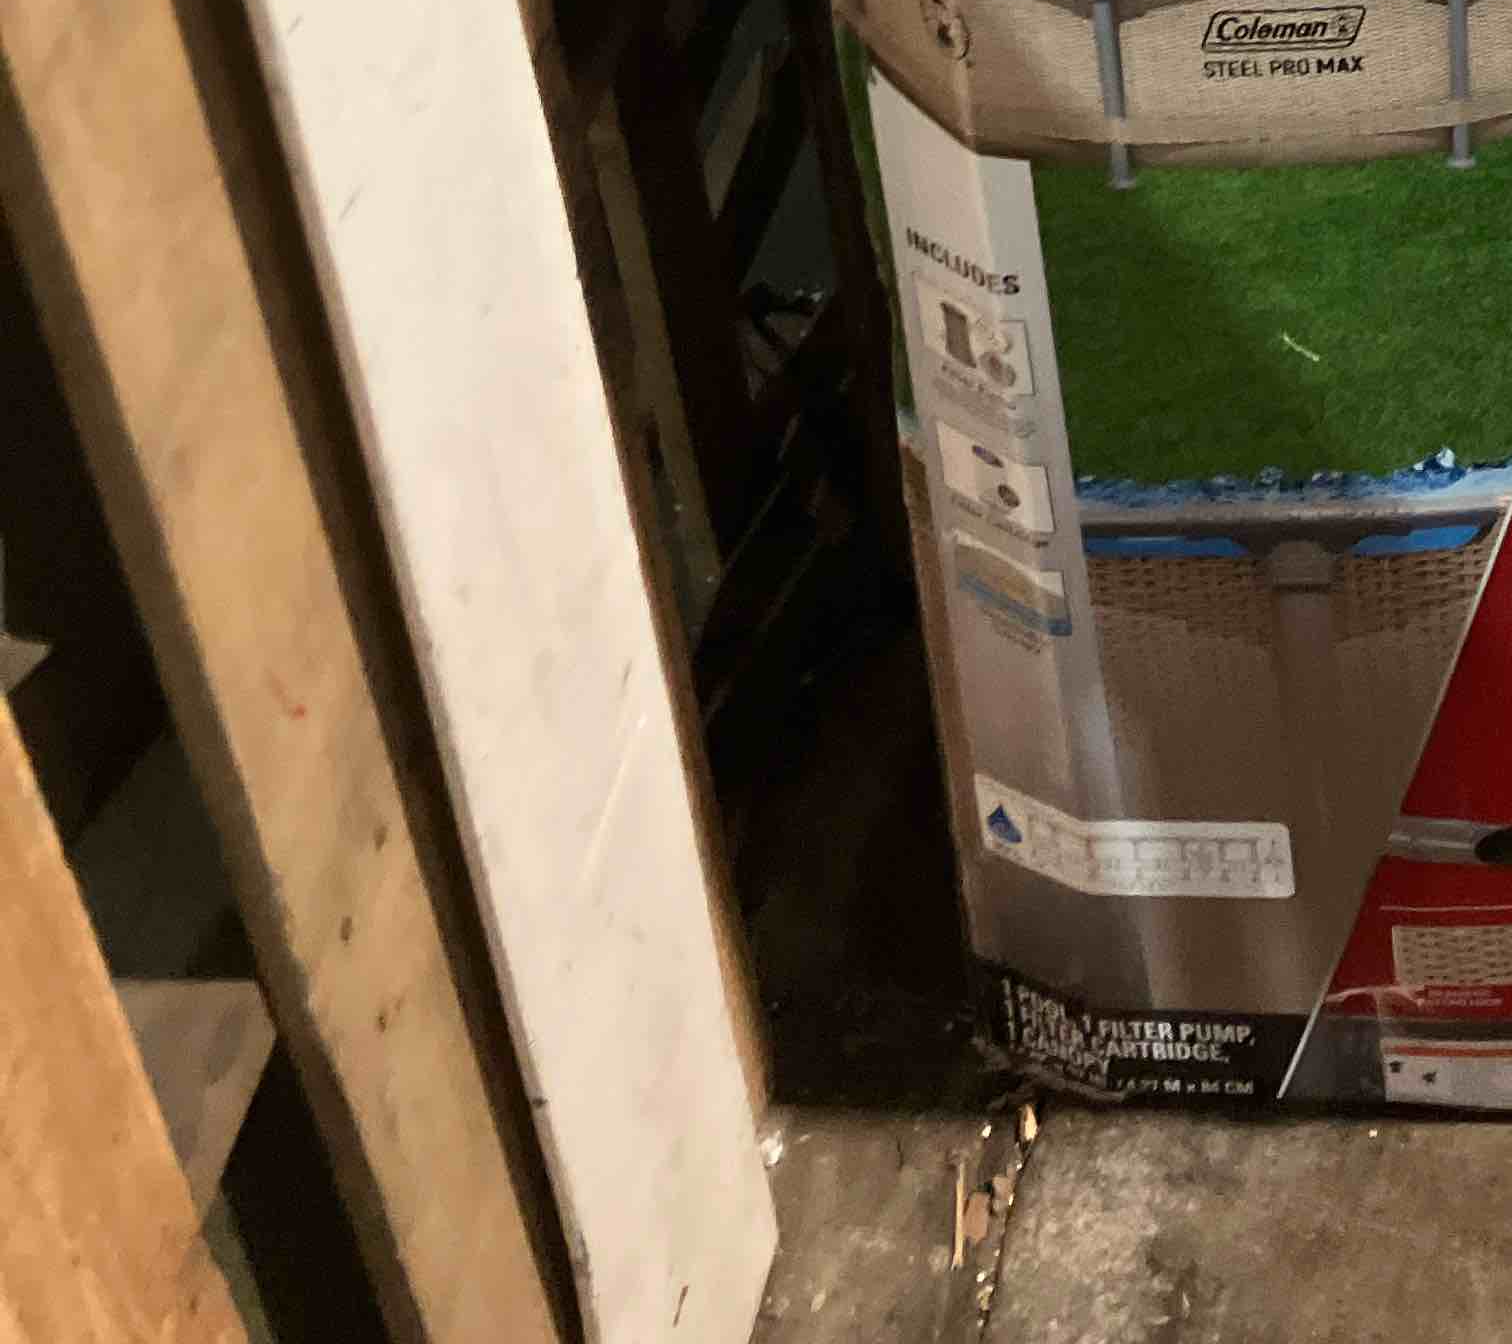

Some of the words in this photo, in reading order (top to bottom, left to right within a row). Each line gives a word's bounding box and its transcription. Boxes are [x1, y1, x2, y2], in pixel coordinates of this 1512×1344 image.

[1215, 15, 1328, 42] Coleman
[1202, 59, 1263, 80] STEEL
[1269, 58, 1310, 76] PRO
[1316, 56, 1366, 75] MAX
[906, 226, 1022, 297] INCLUDES
[1099, 1018, 1174, 1042] FILTER
